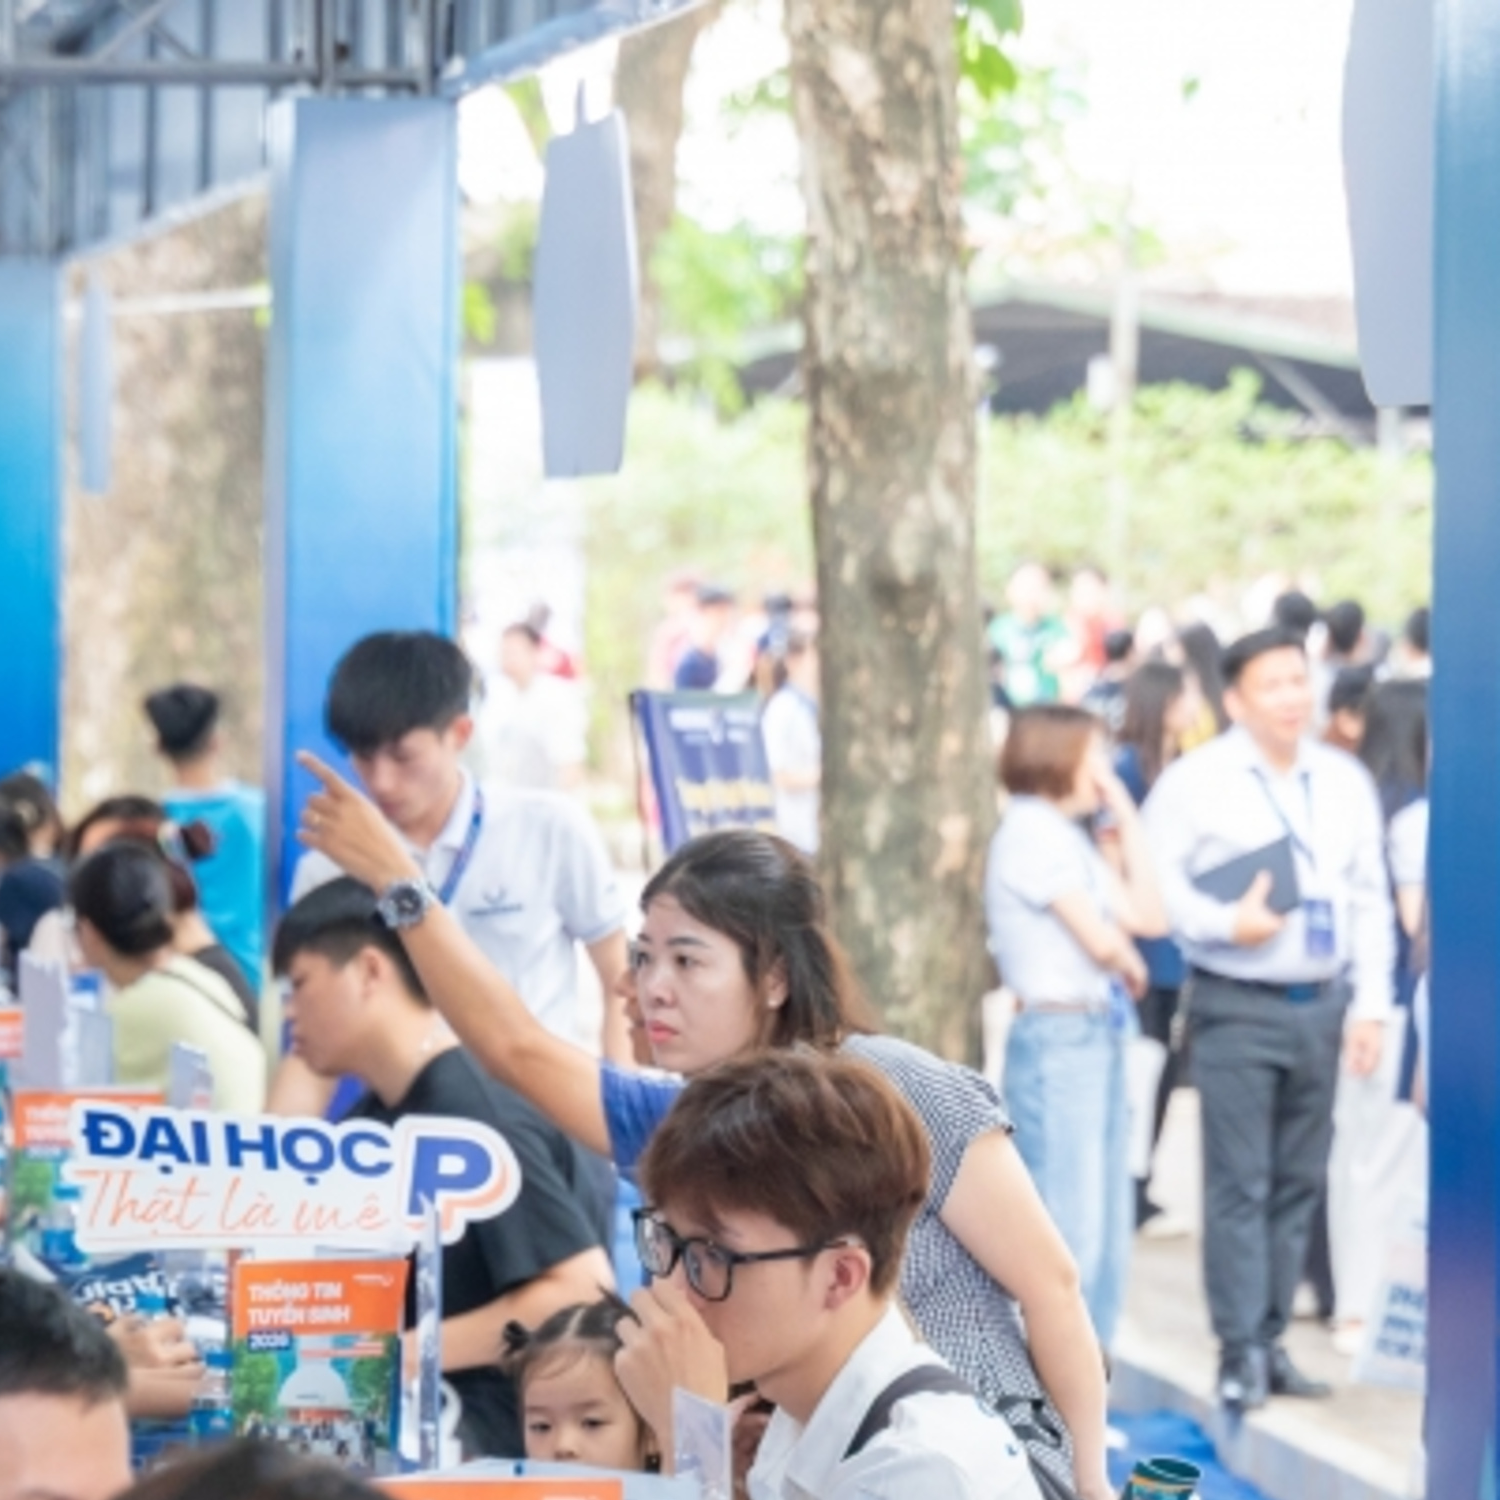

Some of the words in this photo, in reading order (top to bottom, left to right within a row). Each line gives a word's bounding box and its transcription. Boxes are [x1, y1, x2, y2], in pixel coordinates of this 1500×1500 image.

[81, 1111, 211, 1175] ĐẠI
[224, 1122, 395, 1186] HỌC
[407, 1136, 493, 1216] P
[73, 1170, 211, 1236] Thật
[217, 1176, 284, 1231] là
[312, 1281, 343, 1300] TIN
